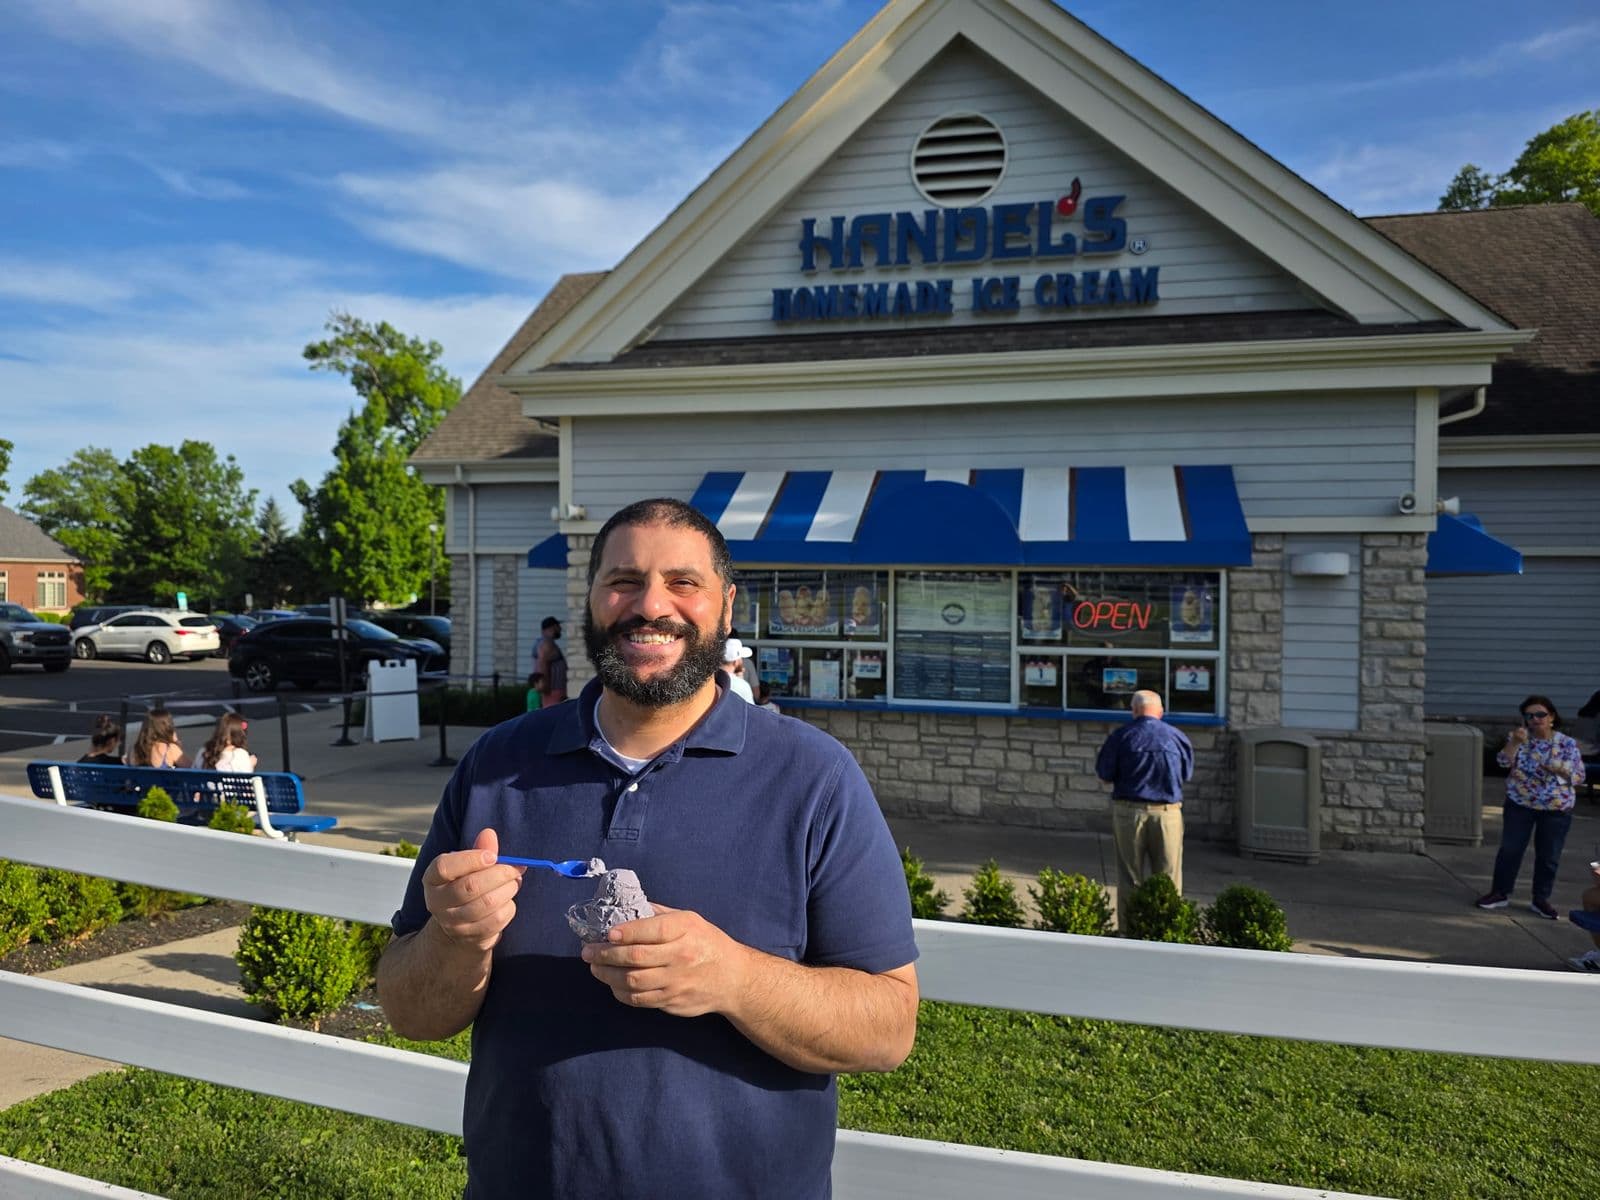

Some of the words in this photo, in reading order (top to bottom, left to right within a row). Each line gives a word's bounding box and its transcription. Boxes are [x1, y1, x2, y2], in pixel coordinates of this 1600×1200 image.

[800, 178, 1128, 271] HANDEL'S
[771, 278, 954, 321] HOMEMADE
[971, 275, 1020, 312] ICE
[1034, 266, 1160, 307] CREAM
[1073, 601, 1151, 630] OPEN
[1188, 671, 1198, 684] 2
